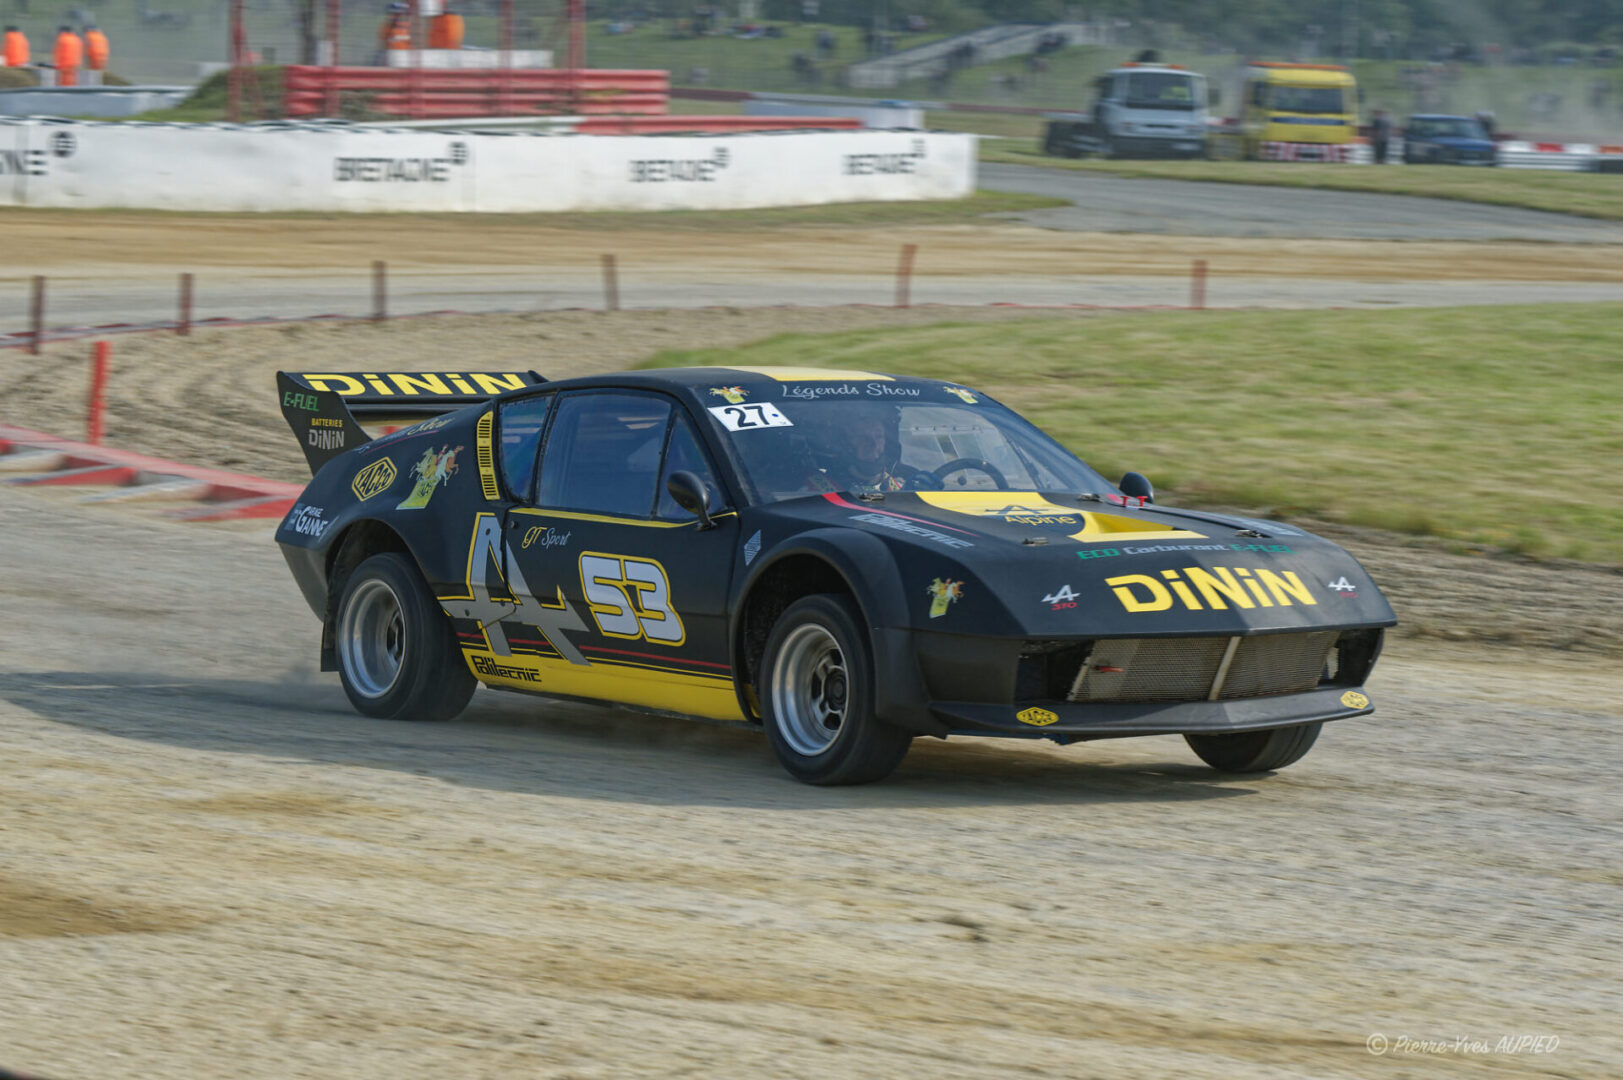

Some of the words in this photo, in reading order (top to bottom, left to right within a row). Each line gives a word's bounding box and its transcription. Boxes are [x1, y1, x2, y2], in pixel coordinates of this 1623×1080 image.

[866, 382, 920, 397] Show
[283, 391, 319, 412] E-FUEL
[311, 417, 344, 428] BATTERIES
[724, 405, 771, 428] 27
[357, 461, 392, 496] YACCO
[1005, 513, 1077, 526] Alpine
[521, 526, 547, 548] GT
[541, 527, 572, 548] Sport
[1076, 547, 1121, 561] ECO
[578, 550, 687, 648] 53
[469, 654, 543, 683] Politecnic
